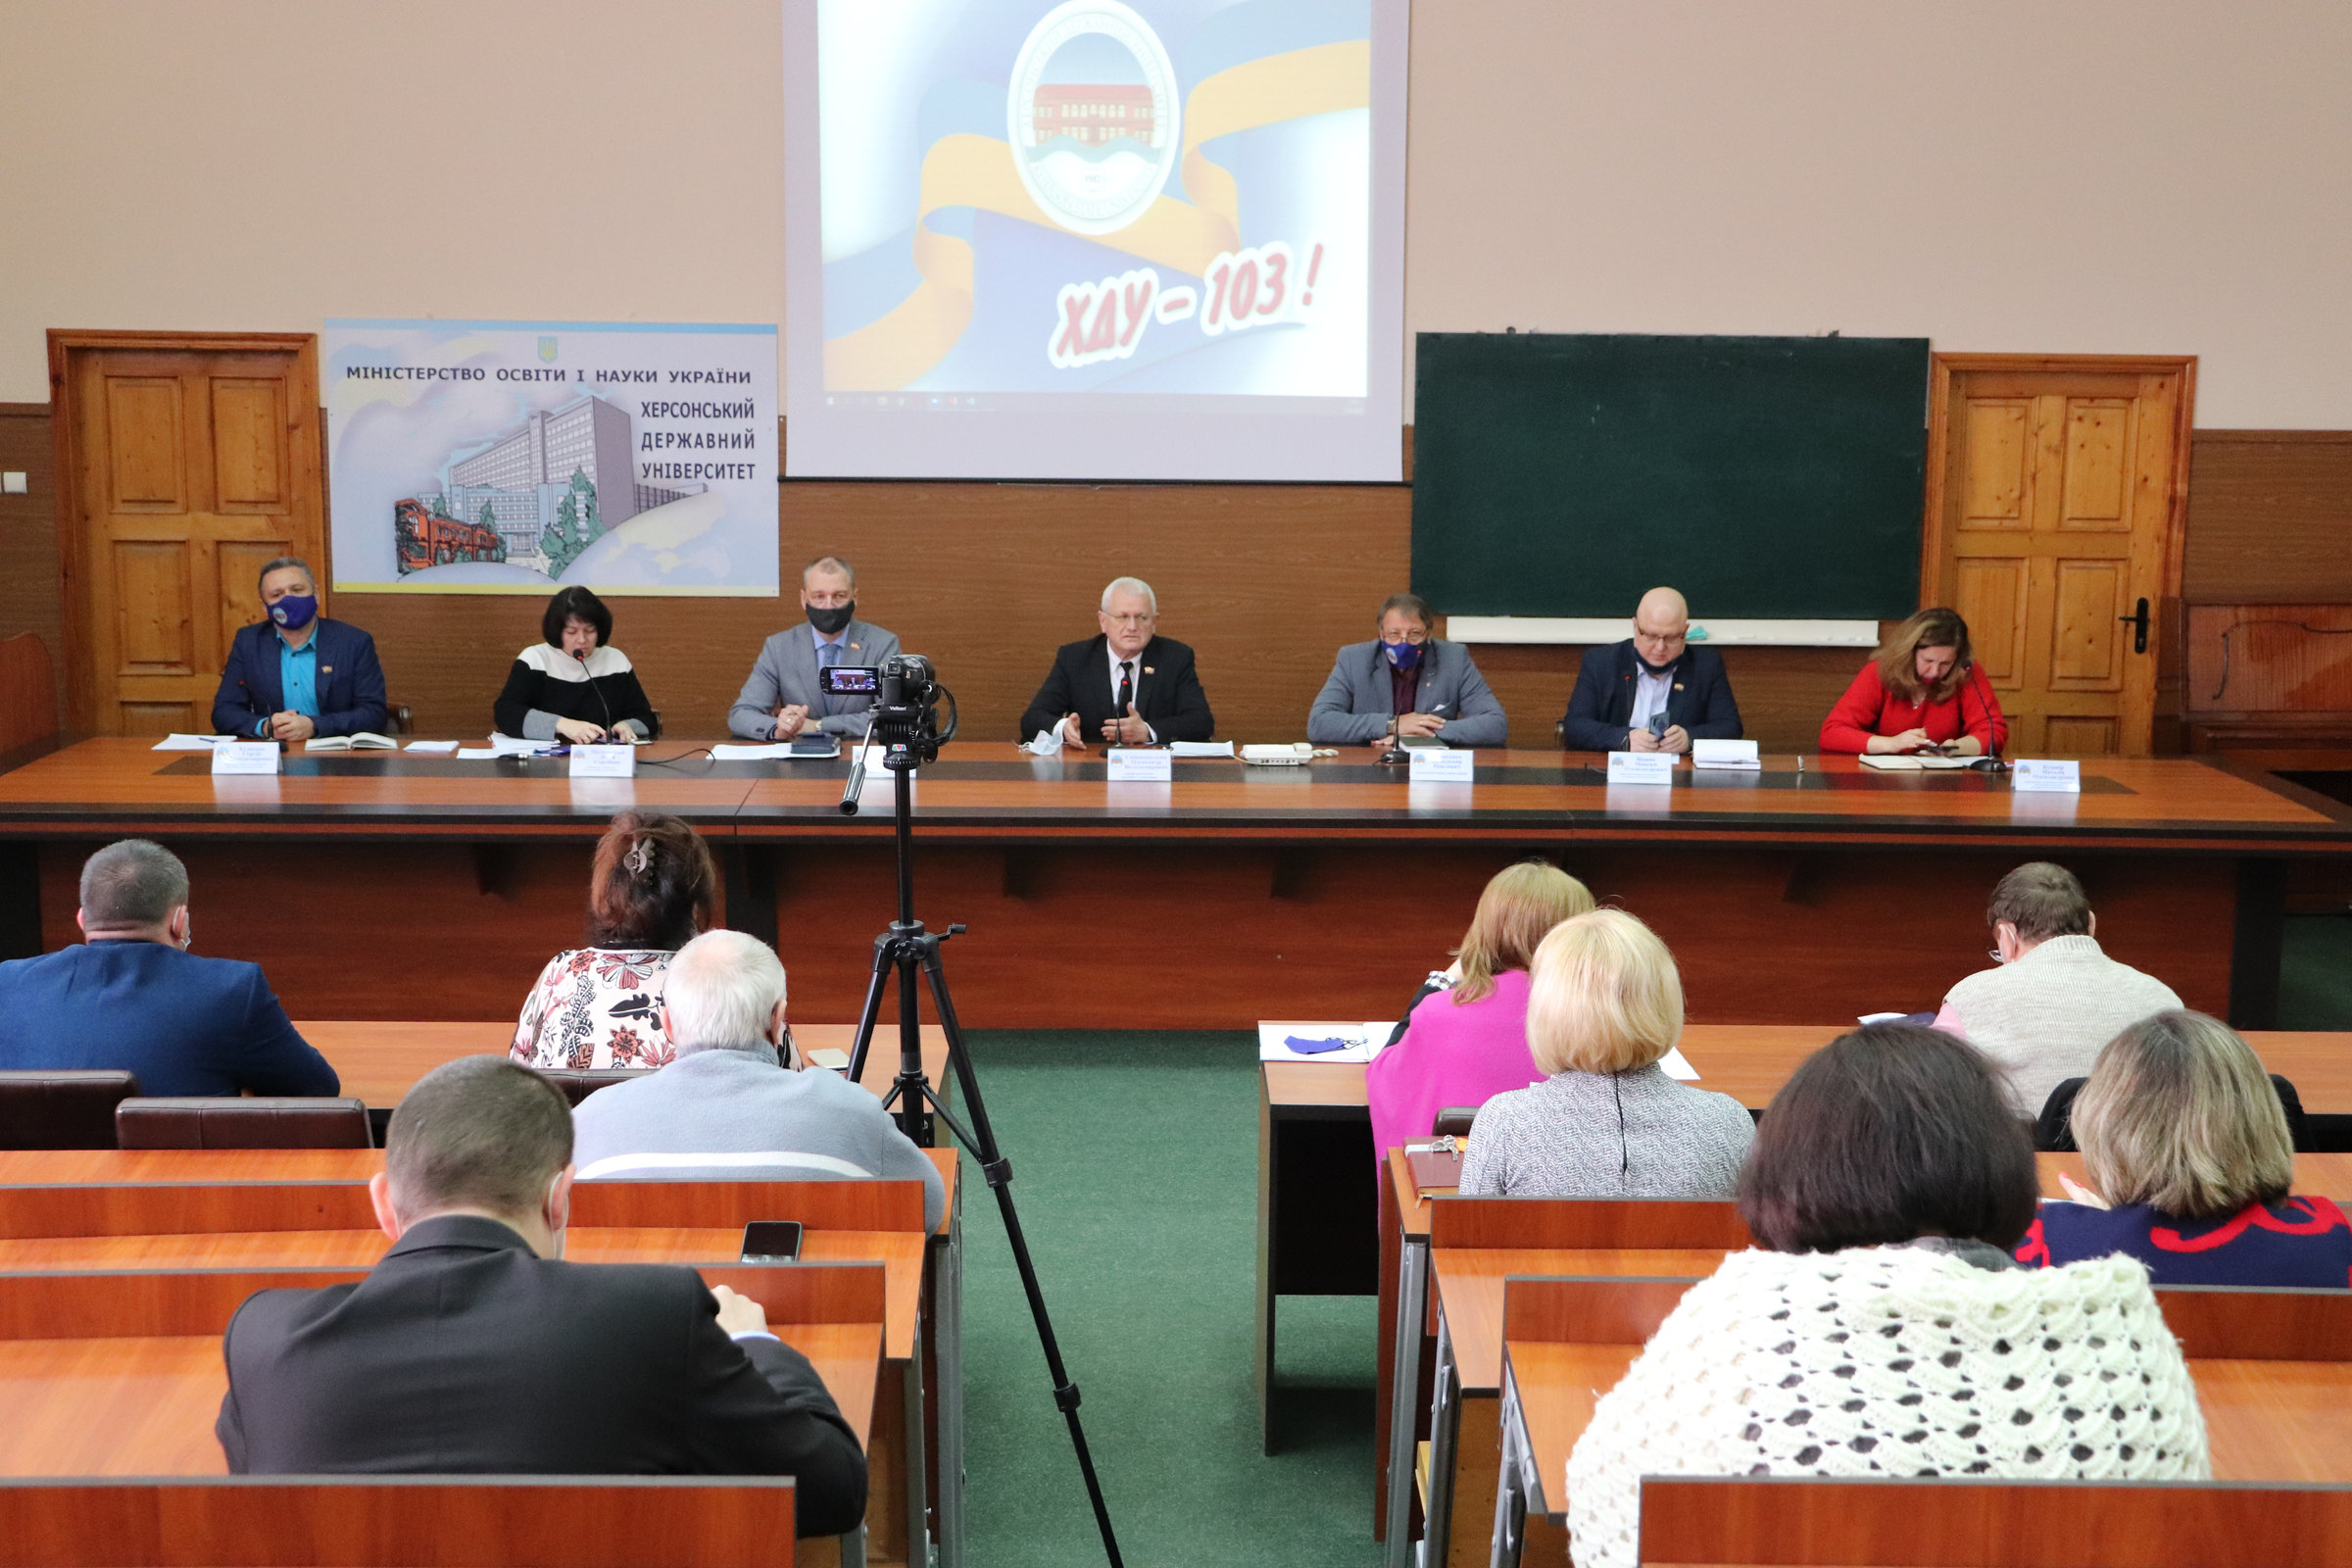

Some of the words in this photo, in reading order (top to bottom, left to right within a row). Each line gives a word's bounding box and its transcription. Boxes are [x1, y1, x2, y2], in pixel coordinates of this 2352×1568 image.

[346, 366, 486, 382] МІНІСТЕРСТВО
[496, 368, 566, 382] ОСВІТИ
[576, 368, 585, 382] І
[595, 368, 659, 384] НАУКИ
[668, 368, 752, 384] УКРАЇНИ
[640, 397, 756, 419] ХЕРСОНСЬКИЙ
[640, 427, 756, 451] ДЕРЖАВНИЙ
[641, 463, 757, 480] УНІВЕРСИТЕТ
